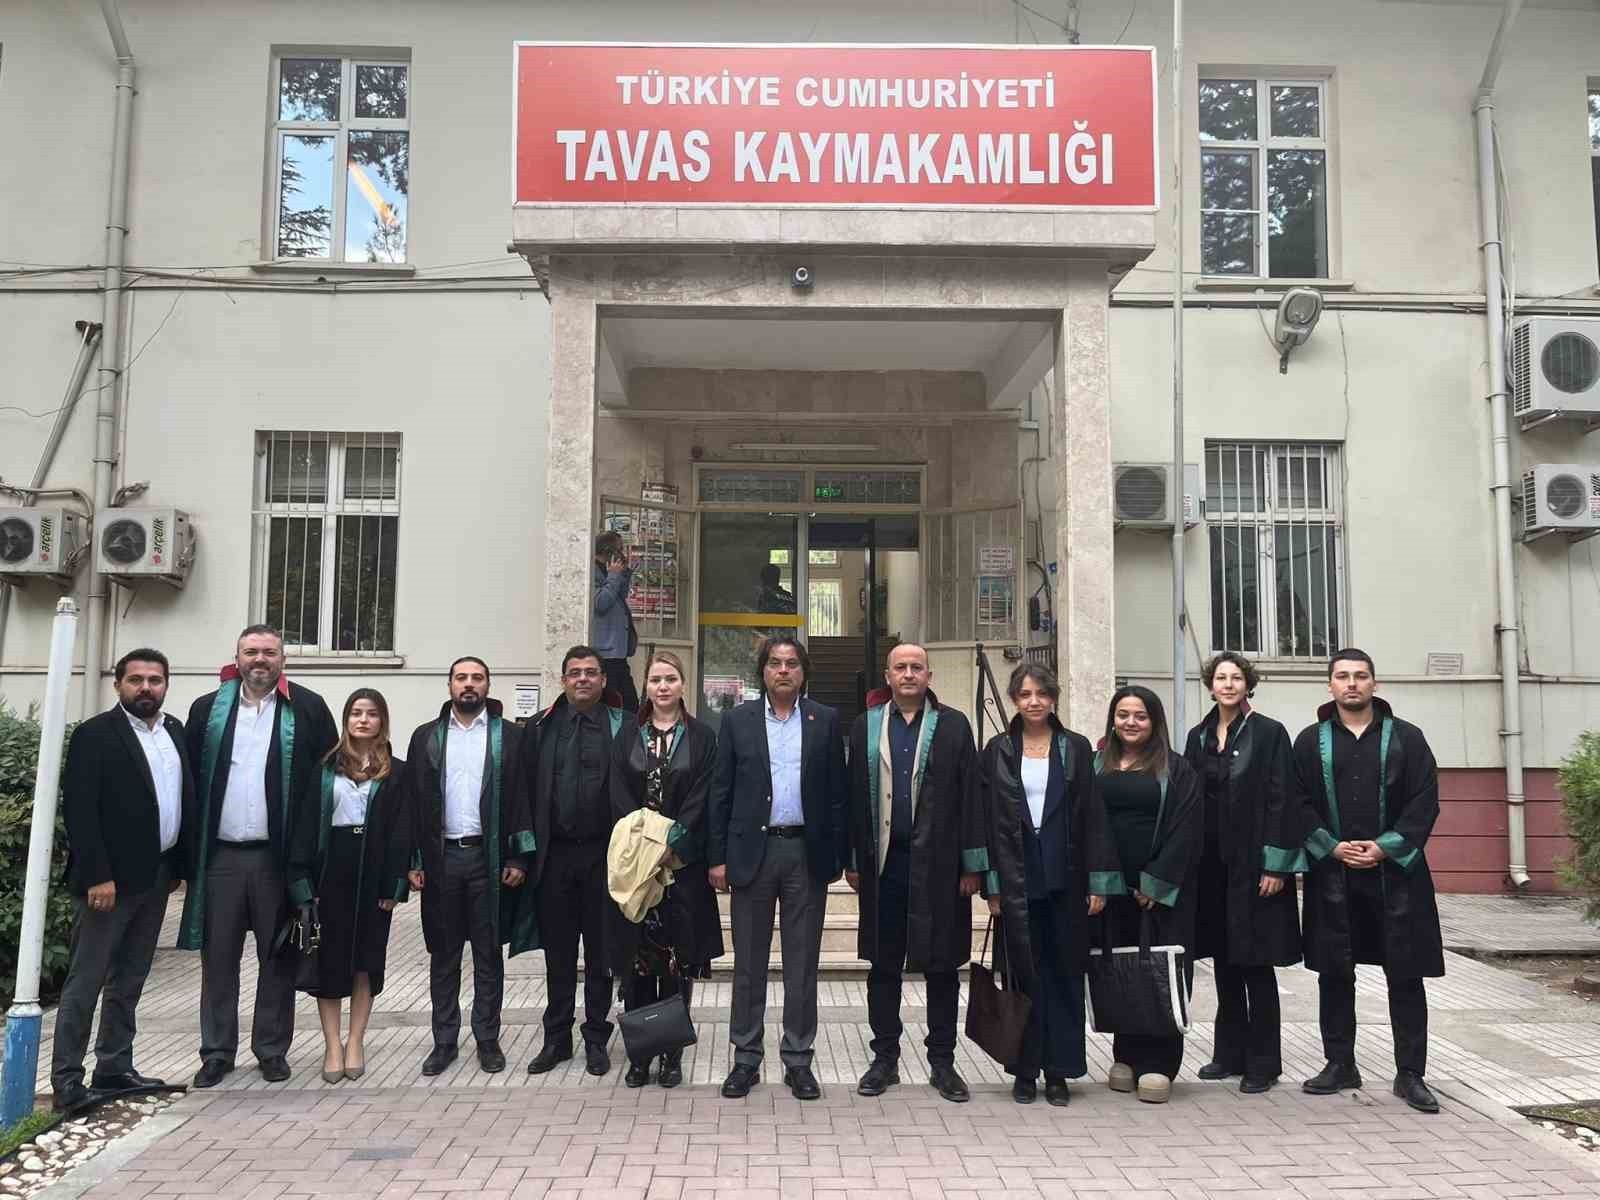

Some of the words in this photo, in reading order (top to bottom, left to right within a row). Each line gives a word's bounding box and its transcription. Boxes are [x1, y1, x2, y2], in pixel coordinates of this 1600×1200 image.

[615, 70, 781, 107] TÜRKİYE
[796, 71, 1055, 109] CUMHURİYETİ
[556, 130, 711, 183] TAVAS
[735, 121, 1113, 186] KAYMAKAMLIĞI
